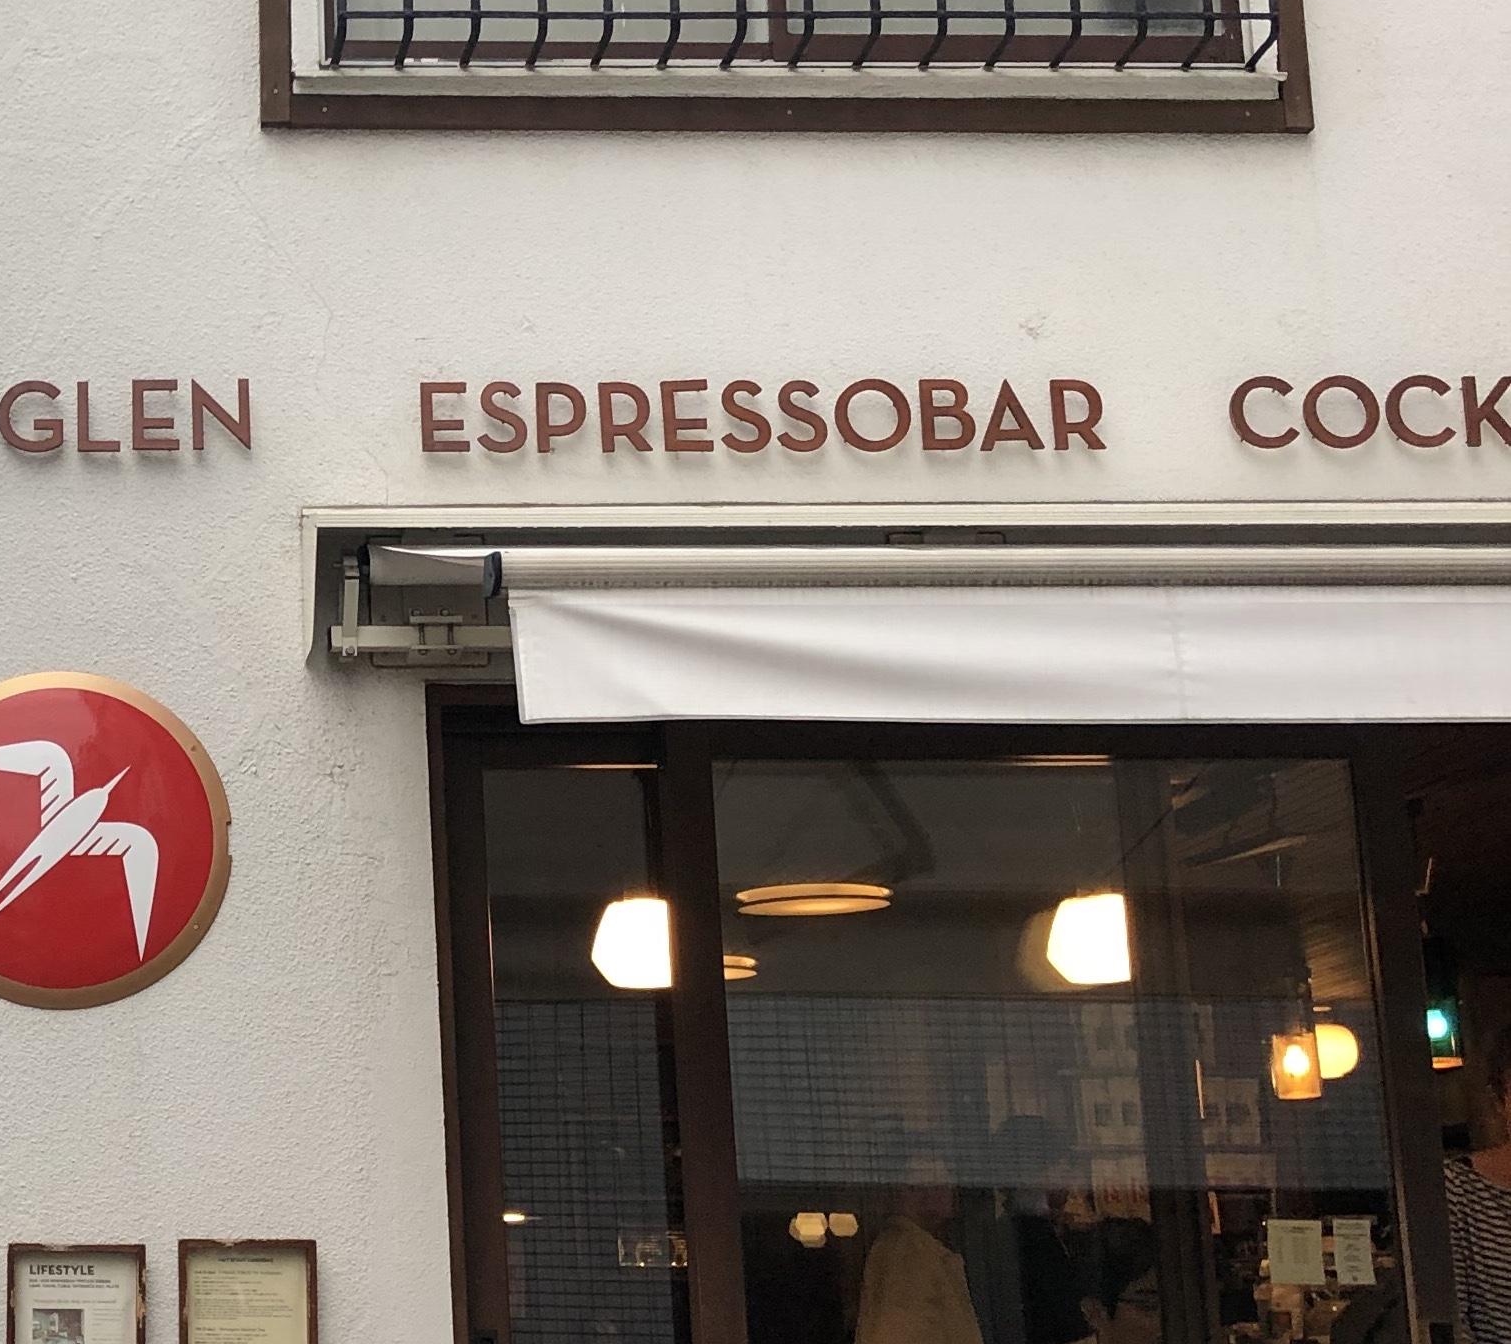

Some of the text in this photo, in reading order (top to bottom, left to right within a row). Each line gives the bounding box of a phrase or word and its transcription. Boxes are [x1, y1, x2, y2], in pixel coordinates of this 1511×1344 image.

[421, 379, 1104, 452] ESPRESSOBAR
[1231, 376, 1511, 448] COCK
[29, 1264, 95, 1276] LIFESTYLE
